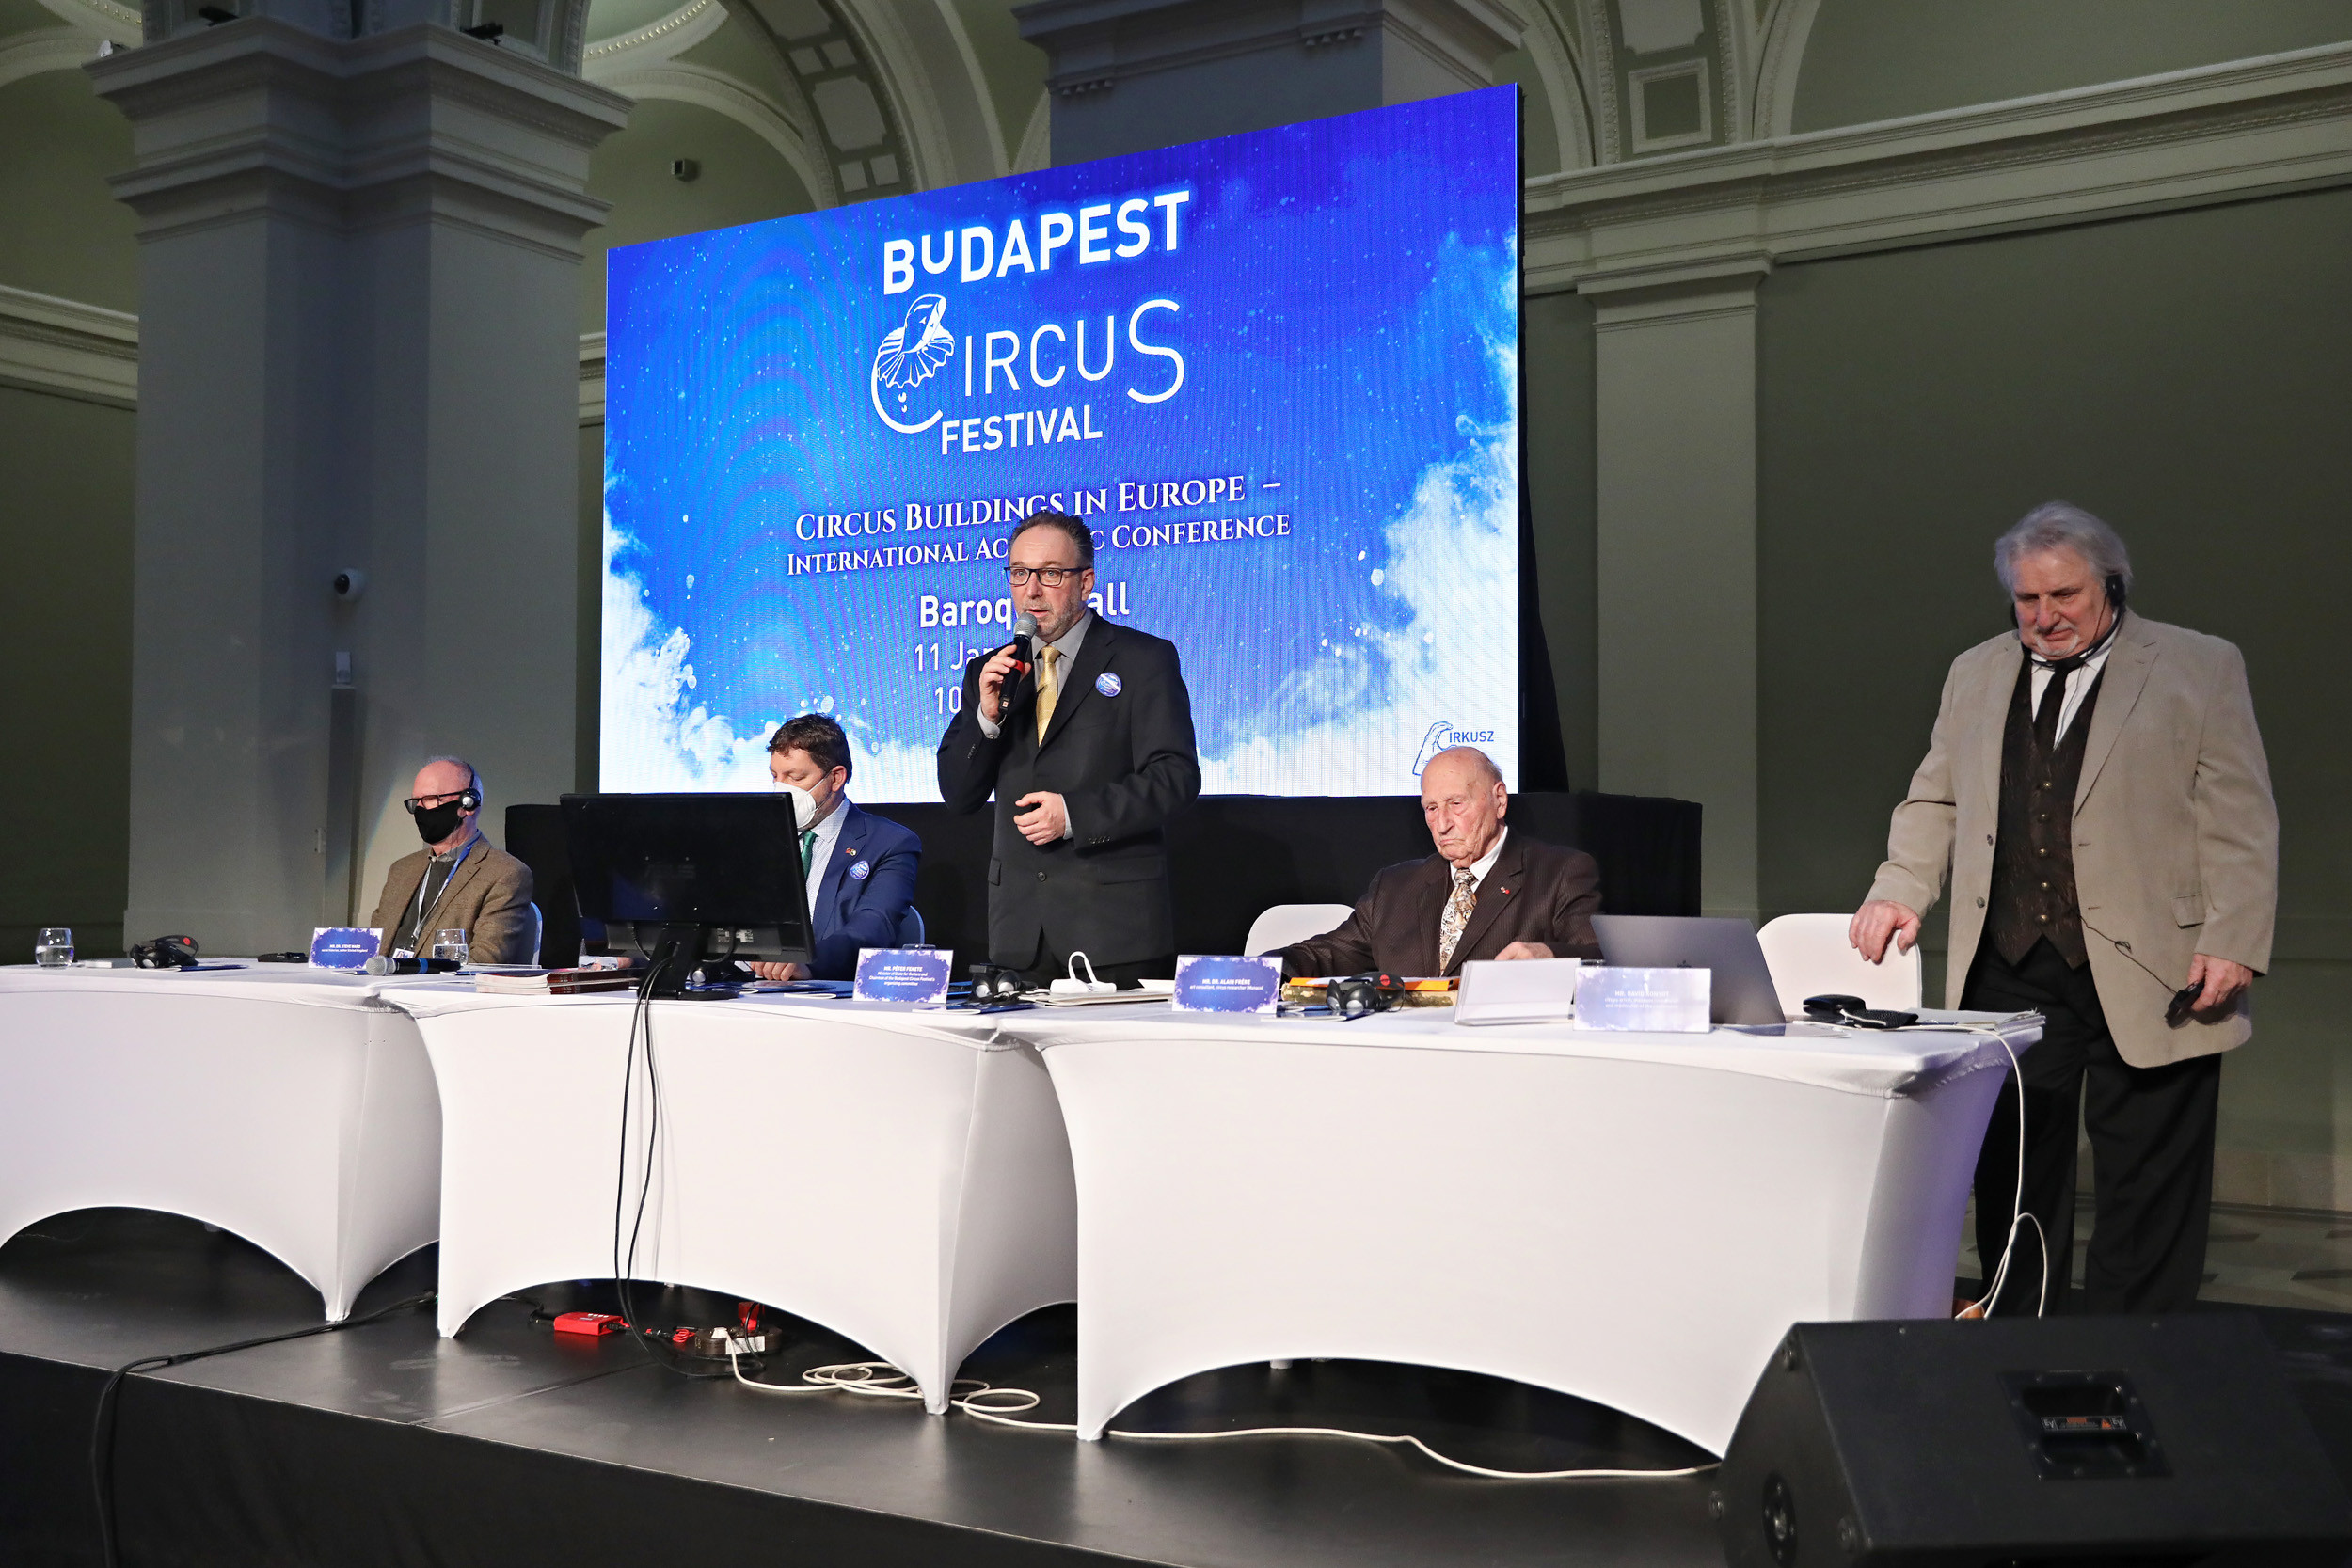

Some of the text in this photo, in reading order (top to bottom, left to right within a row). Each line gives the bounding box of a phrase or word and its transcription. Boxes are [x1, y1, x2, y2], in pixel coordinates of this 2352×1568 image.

[883, 190, 1190, 295] BUDAPEST
[942, 404, 1103, 455] FESTIVAL
[796, 509, 897, 541] CIRCUS
[1118, 475, 1246, 513] EUROPE
[787, 541, 970, 576] INTERNATIONAL
[1111, 514, 1291, 549] CONFERENCE
[920, 581, 1130, 631] Baroq all
[914, 642, 939, 672] 11
